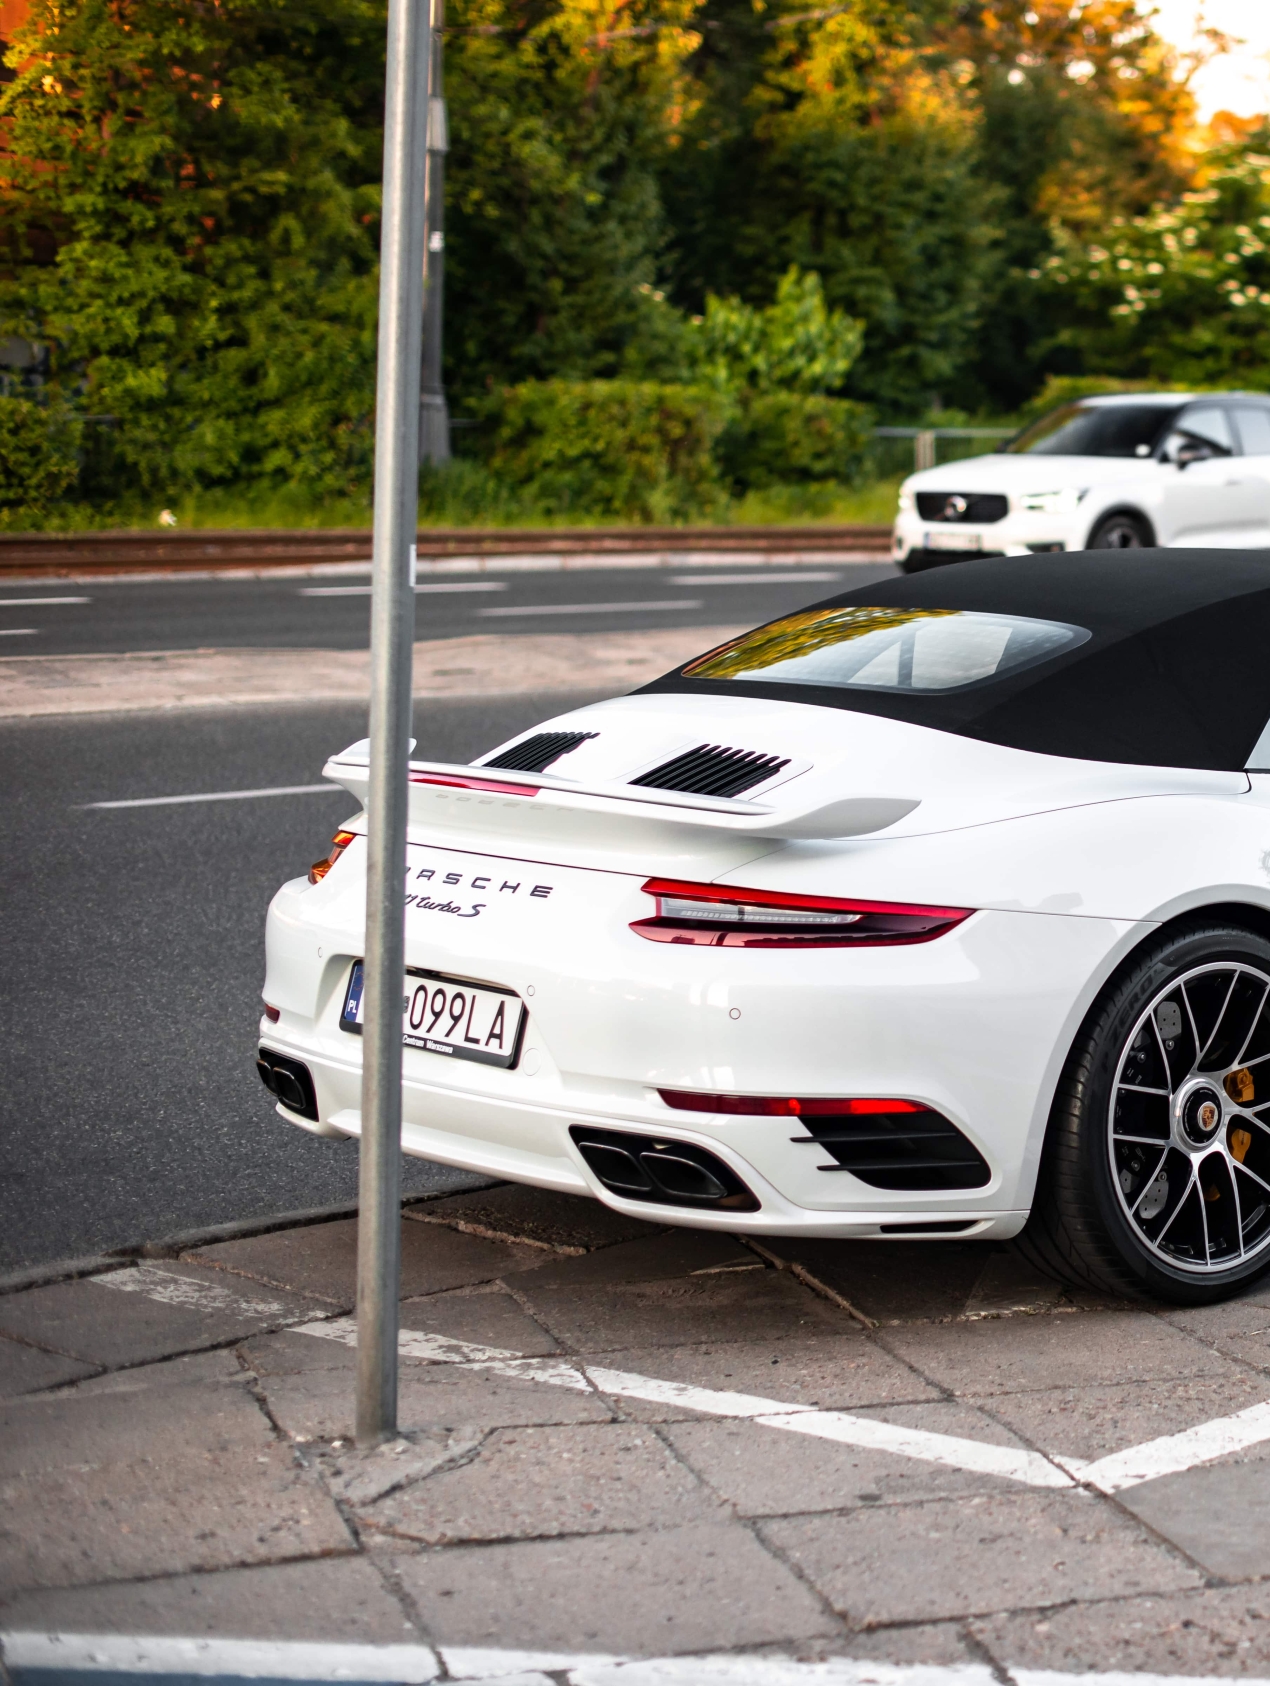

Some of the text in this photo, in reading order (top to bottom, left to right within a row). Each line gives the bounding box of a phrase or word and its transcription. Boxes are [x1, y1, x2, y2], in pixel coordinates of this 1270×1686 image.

[405, 866, 553, 898] RSCHE
[415, 896, 461, 914] turbo
[457, 903, 487, 917] S
[348, 1000, 357, 1013] PL
[409, 984, 505, 1050] 099LA
